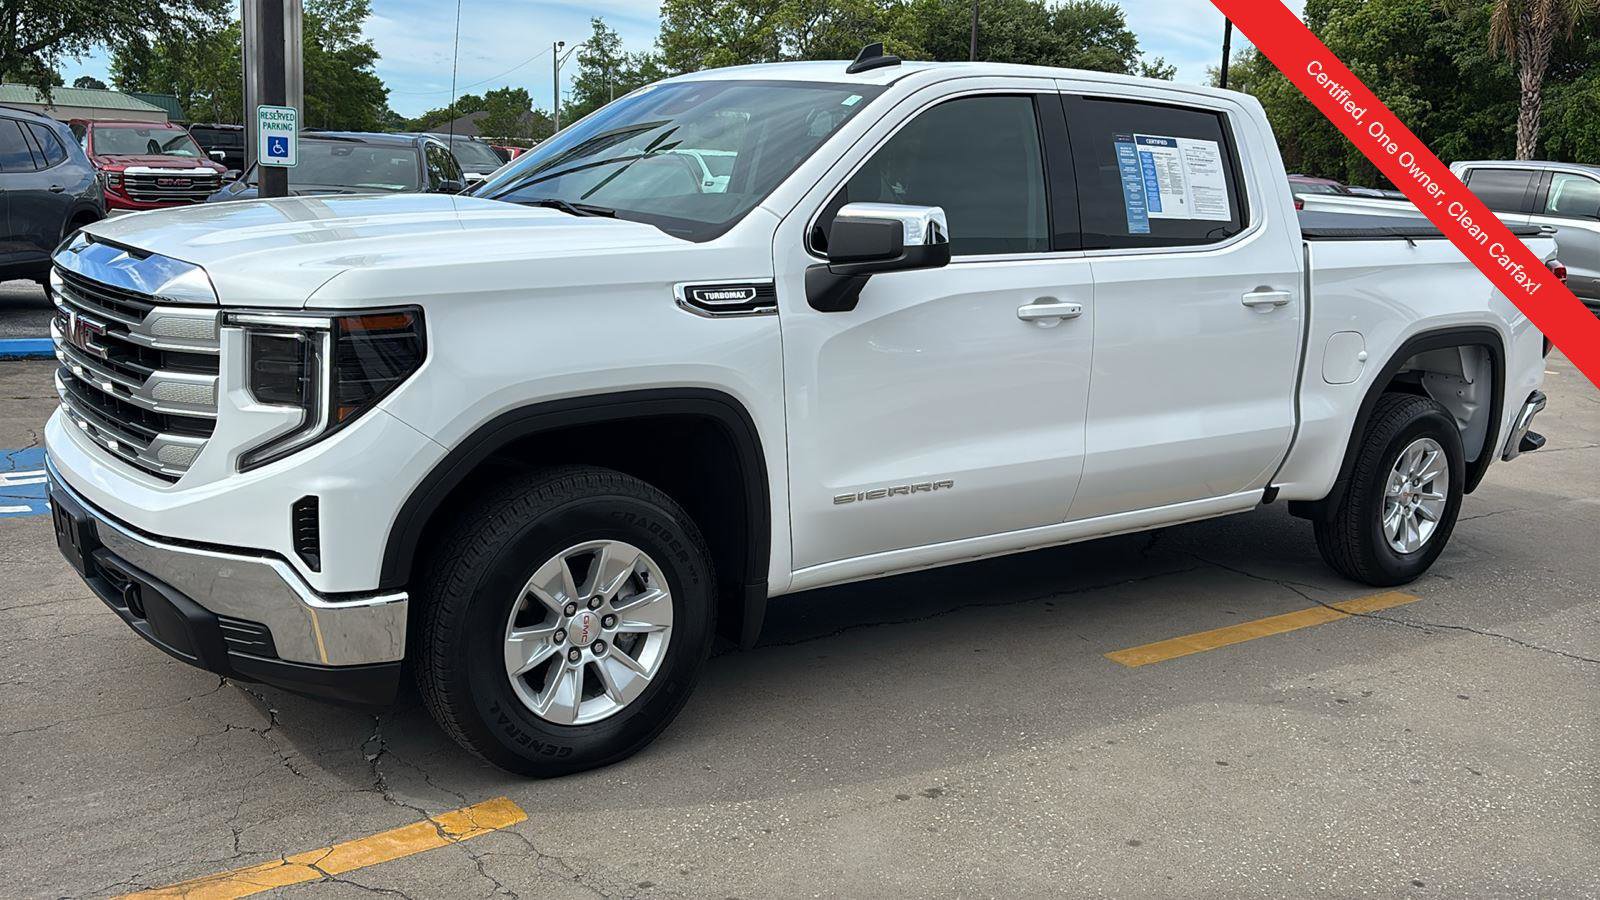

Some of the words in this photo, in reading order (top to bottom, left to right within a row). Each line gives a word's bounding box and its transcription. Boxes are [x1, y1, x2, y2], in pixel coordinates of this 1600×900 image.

[260, 111, 295, 121] RESERVED
[262, 121, 293, 131] PARKING
[157, 178, 191, 186] GMC
[703, 290, 747, 300] TURBOMAX
[833, 479, 954, 505] SIERRA
[581, 615, 590, 643] GMC
[489, 700, 574, 758] GENERAL
